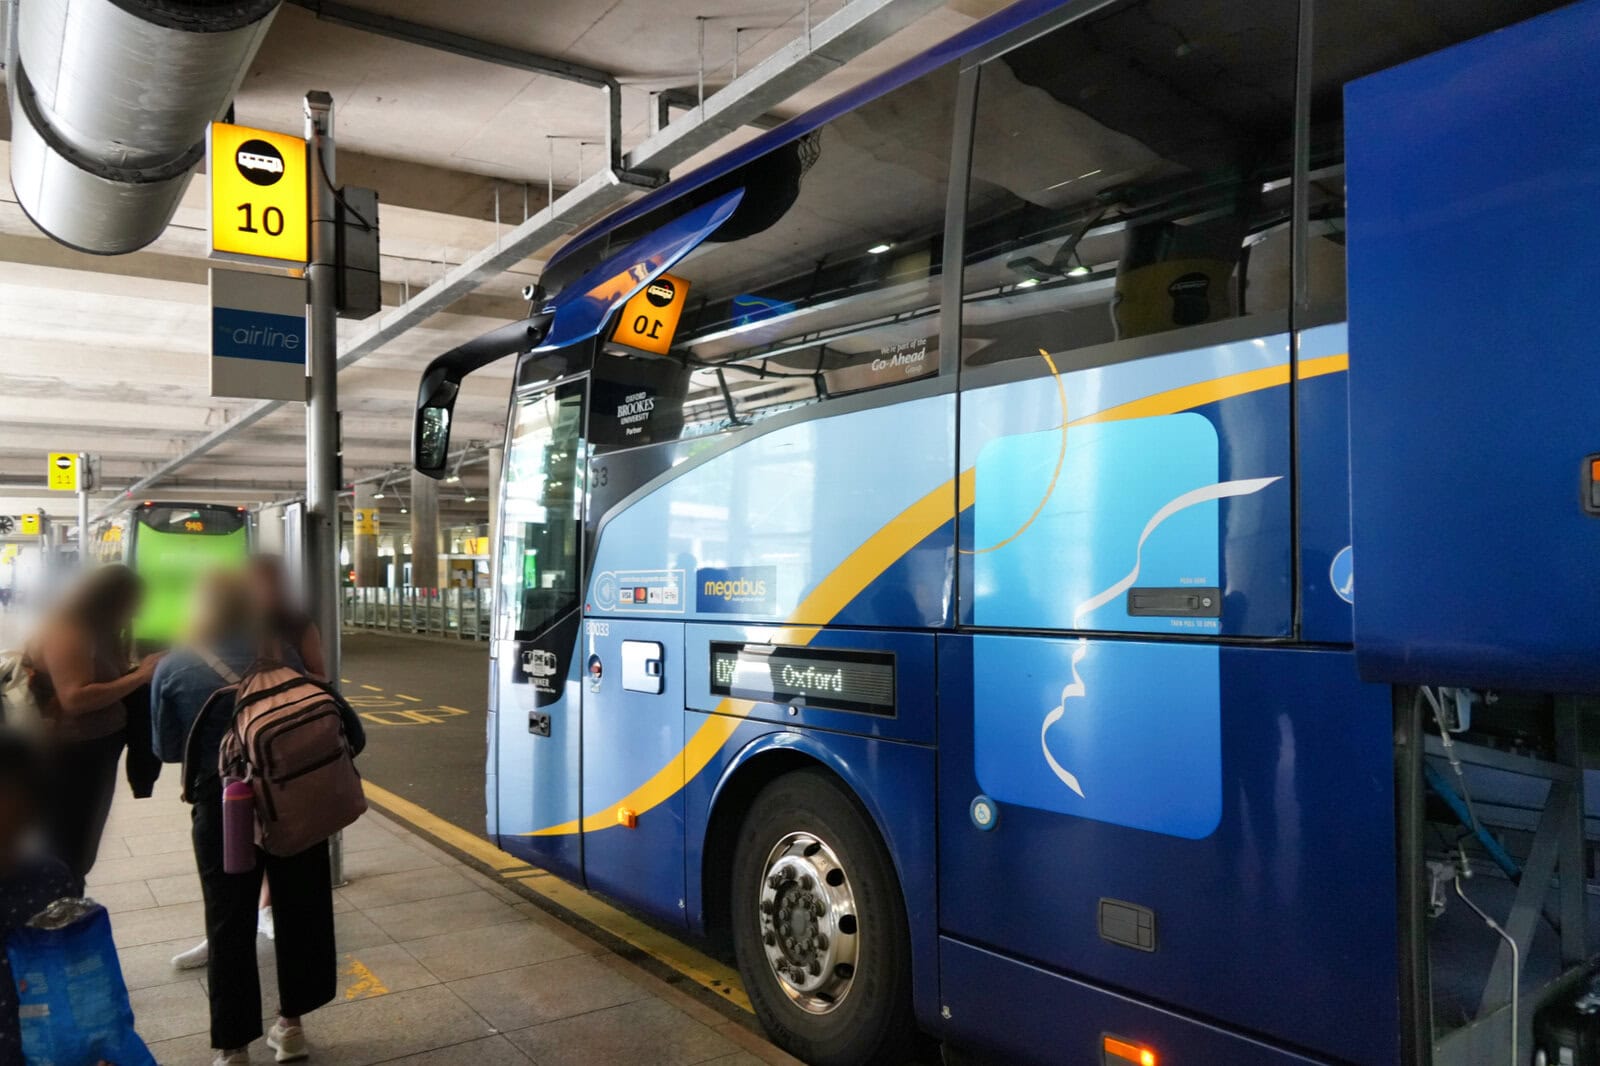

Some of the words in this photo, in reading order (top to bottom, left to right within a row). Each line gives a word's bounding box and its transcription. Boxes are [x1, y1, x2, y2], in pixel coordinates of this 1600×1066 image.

[236, 202, 284, 237] 10
[233, 325, 299, 350] airline
[871, 347, 926, 371] Go-Ahead
[617, 397, 655, 418] BROOKES
[620, 412, 650, 425] UNIVERSITY
[704, 576, 767, 601] megabus
[782, 664, 842, 692] Oxford
